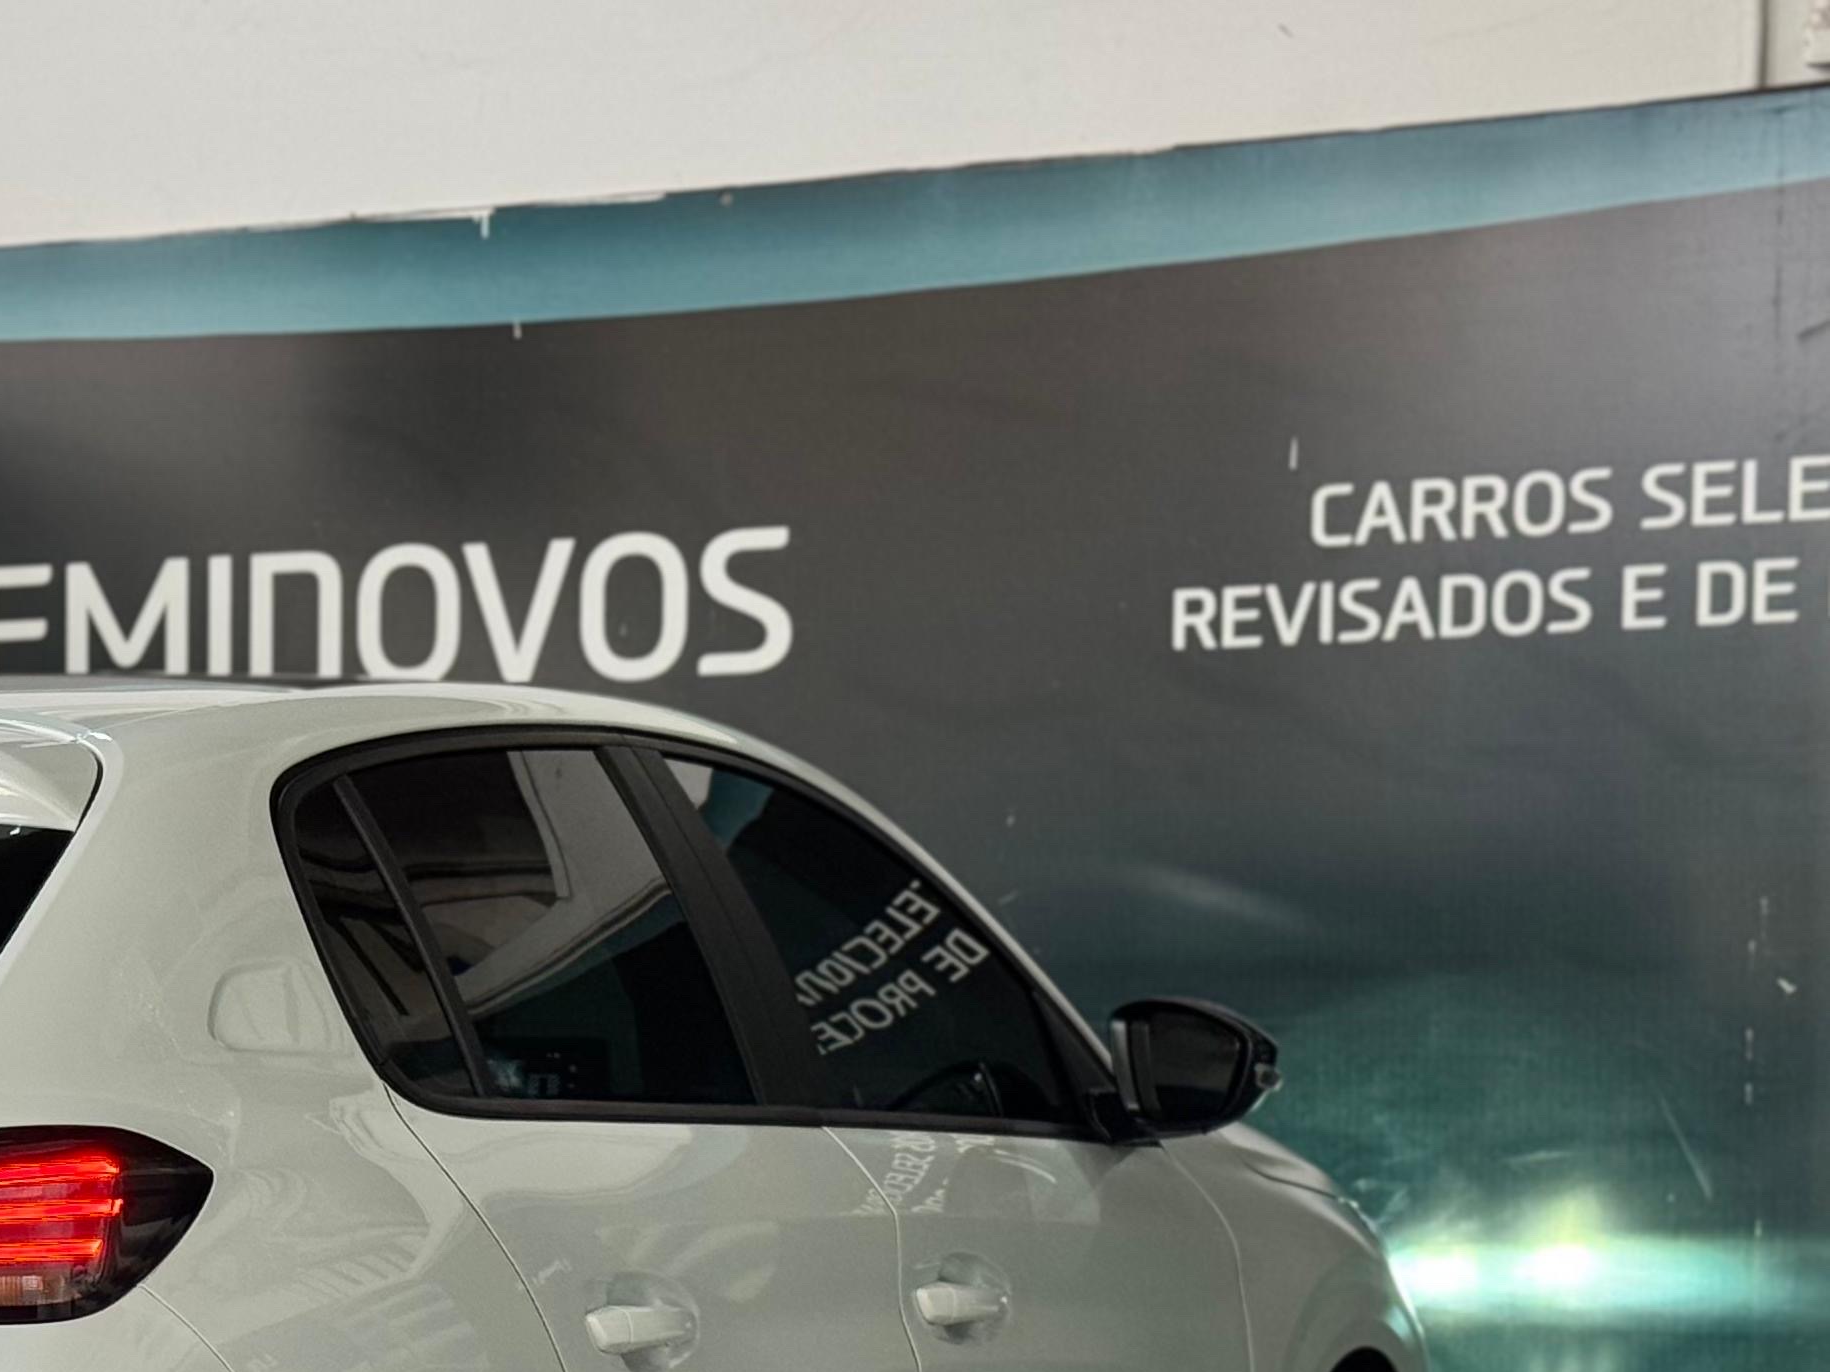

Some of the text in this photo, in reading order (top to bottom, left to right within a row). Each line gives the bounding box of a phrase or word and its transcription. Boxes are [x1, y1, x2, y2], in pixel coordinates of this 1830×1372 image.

[1309, 455, 1830, 549] CARROS SELE
[1171, 567, 1593, 652] REVISADOS
[1621, 563, 1668, 631] E
[1695, 557, 1800, 628] DE
